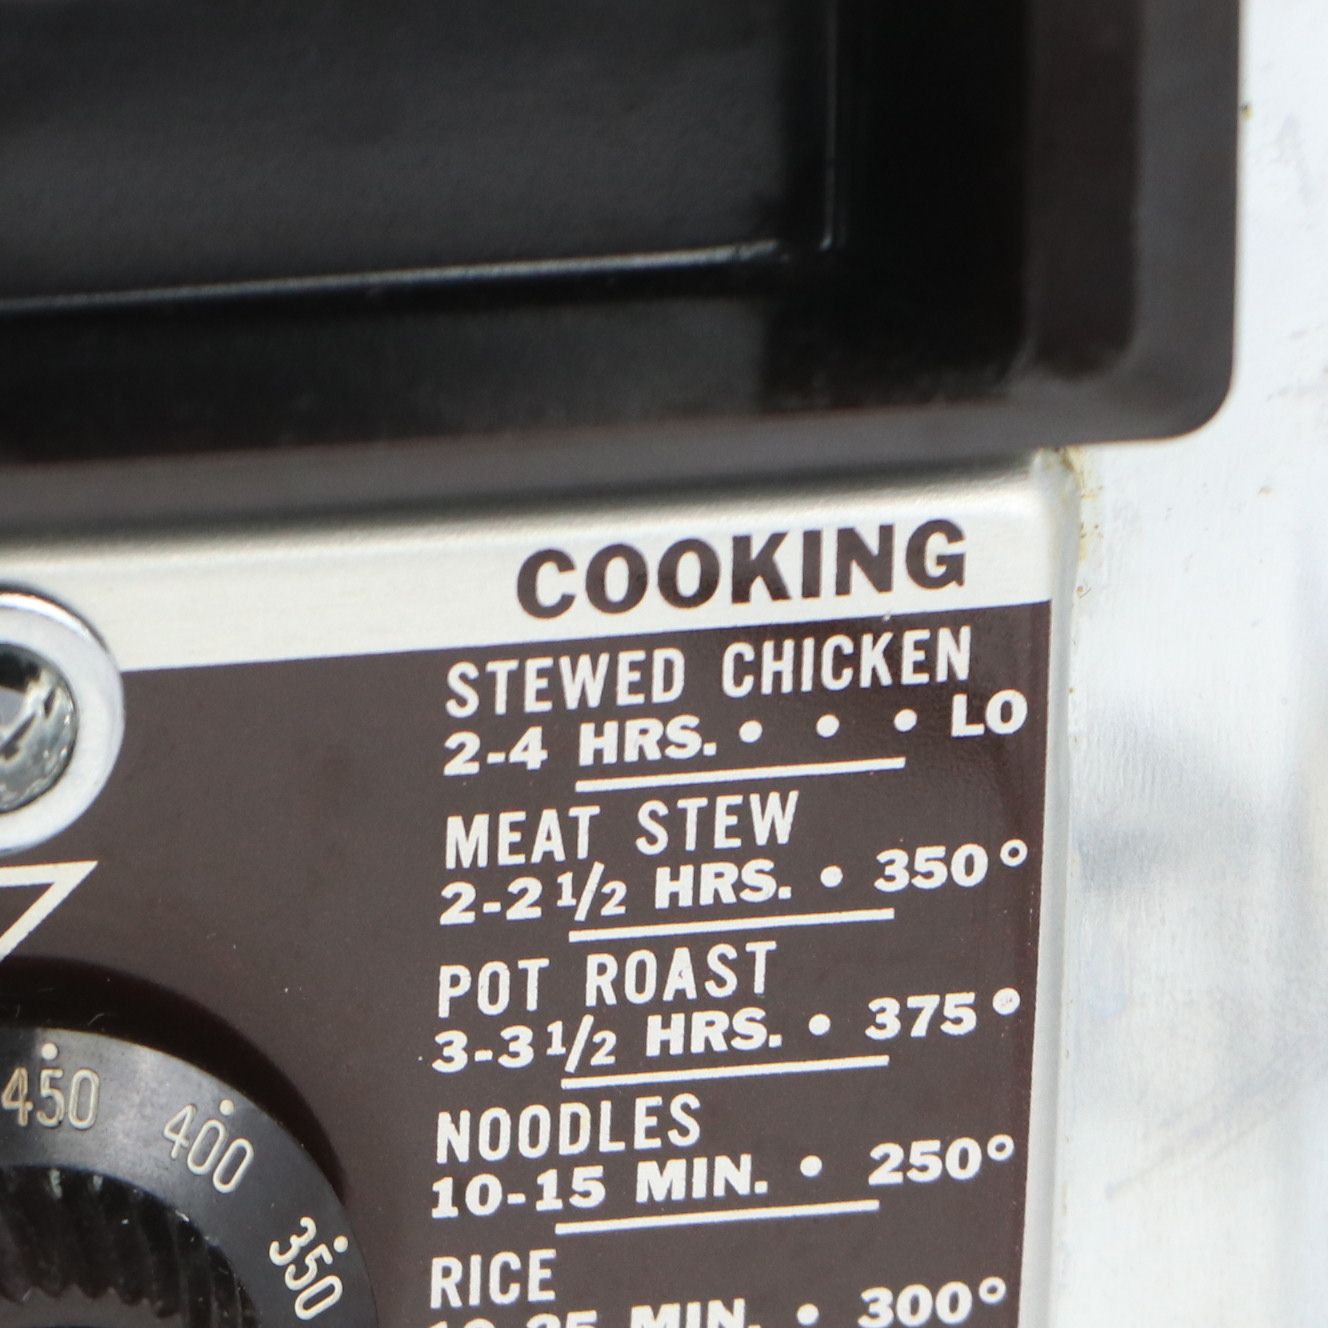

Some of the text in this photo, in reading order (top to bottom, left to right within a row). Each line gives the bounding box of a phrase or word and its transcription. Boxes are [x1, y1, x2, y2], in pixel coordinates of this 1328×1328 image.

[516, 518, 965, 620] COOKING
[445, 625, 972, 718] STEWED CHICKEN
[443, 689, 1028, 776] 2-4 HRS. LO
[445, 790, 799, 870] MEAT STEW
[654, 858, 792, 909] HRS.
[438, 940, 777, 1019] POT ROAST
[645, 1006, 782, 1057] HRS.
[0, 1065, 102, 1132] 450
[436, 1092, 701, 1164] NOODLES
[162, 1102, 256, 1195] 400
[431, 1165, 606, 1219] 10-15
[635, 1153, 768, 1203] MIN.
[268, 1215, 343, 1322] 350
[430, 1248, 557, 1309] RICE
